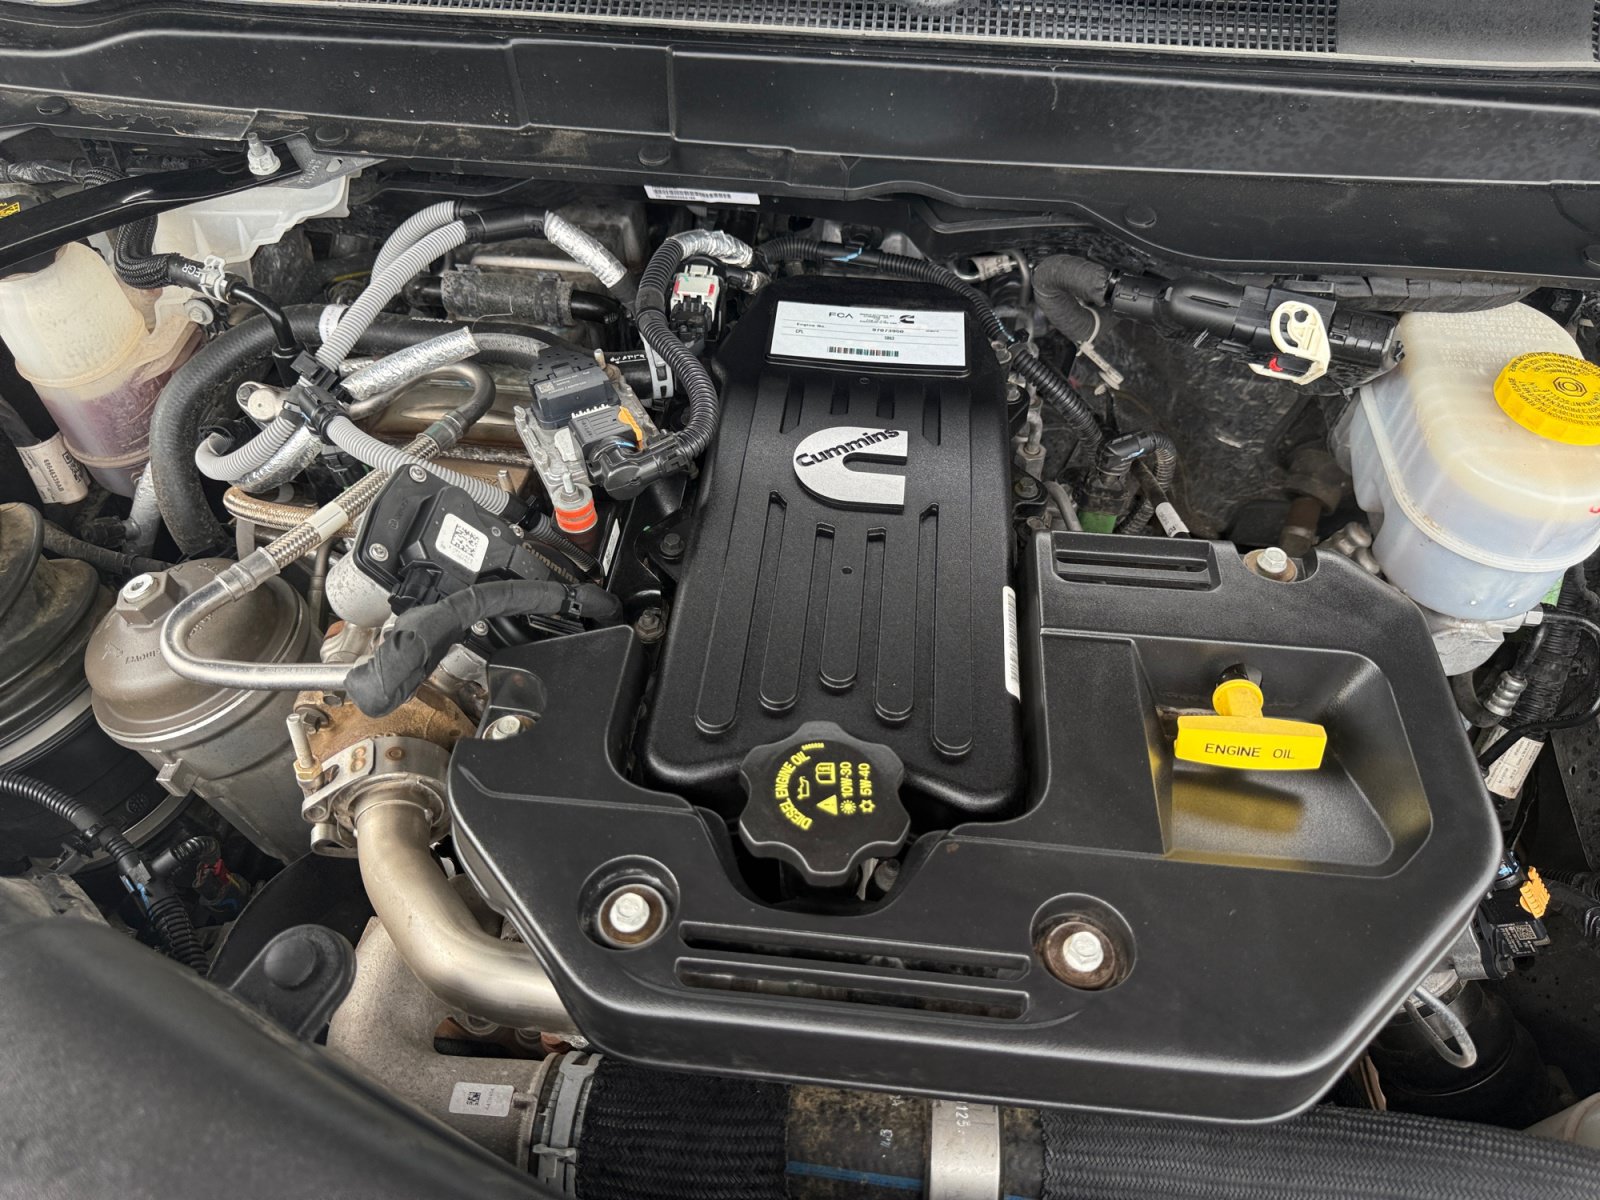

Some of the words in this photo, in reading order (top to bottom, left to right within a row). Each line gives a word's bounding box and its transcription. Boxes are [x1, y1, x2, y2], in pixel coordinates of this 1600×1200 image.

[182, 263, 201, 278] EGR
[829, 311, 854, 319] FCA
[795, 428, 900, 467] Cummins
[790, 750, 811, 767] OIL
[1204, 742, 1262, 758] ENGINE
[1272, 748, 1296, 760] OIL
[775, 761, 797, 799] ENGINE
[840, 761, 854, 798] 10W-30
[858, 762, 873, 796] 5W-40
[779, 797, 813, 831] DIESEL
